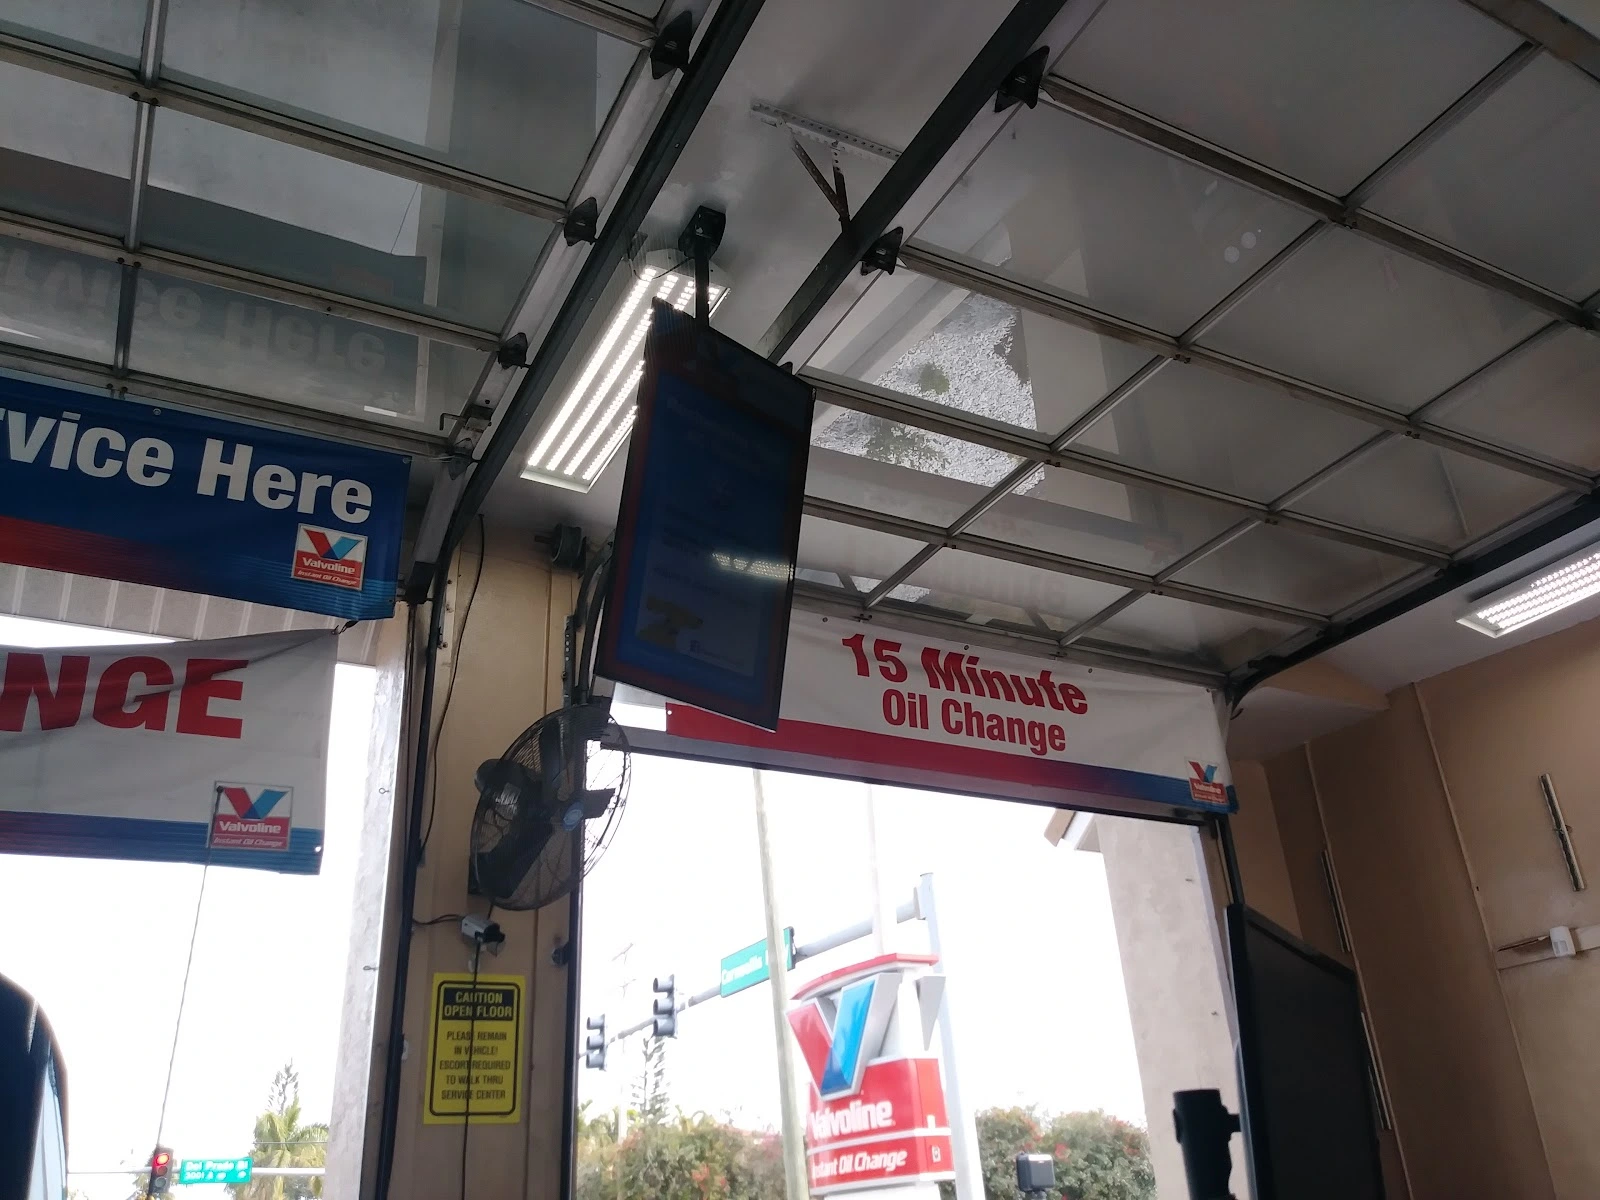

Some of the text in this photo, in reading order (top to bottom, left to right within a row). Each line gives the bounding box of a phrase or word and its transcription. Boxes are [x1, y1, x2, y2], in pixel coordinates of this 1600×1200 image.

[0, 406, 372, 523] vice Here
[302, 557, 356, 575] Valvoline
[297, 570, 357, 586] Instant Oil Change
[841, 633, 1089, 715] 15 Minute
[0, 652, 249, 739] NGE
[882, 688, 1066, 757] Oil Change
[220, 820, 282, 834] Valvoline
[455, 991, 503, 1004] CAUTION
[444, 1005, 512, 1018] OPEN FLOOR
[477, 1031, 507, 1041] REMAIN
[454, 1045, 462, 1055] IN
[440, 1060, 511, 1070] ESCORT REQUIRED
[446, 1075, 456, 1085] TO
[483, 1075, 504, 1085] THRU
[476, 1090, 506, 1100] CENTER
[810, 1099, 894, 1140] Valvoline
[811, 1150, 908, 1180] Instant Oil Change
